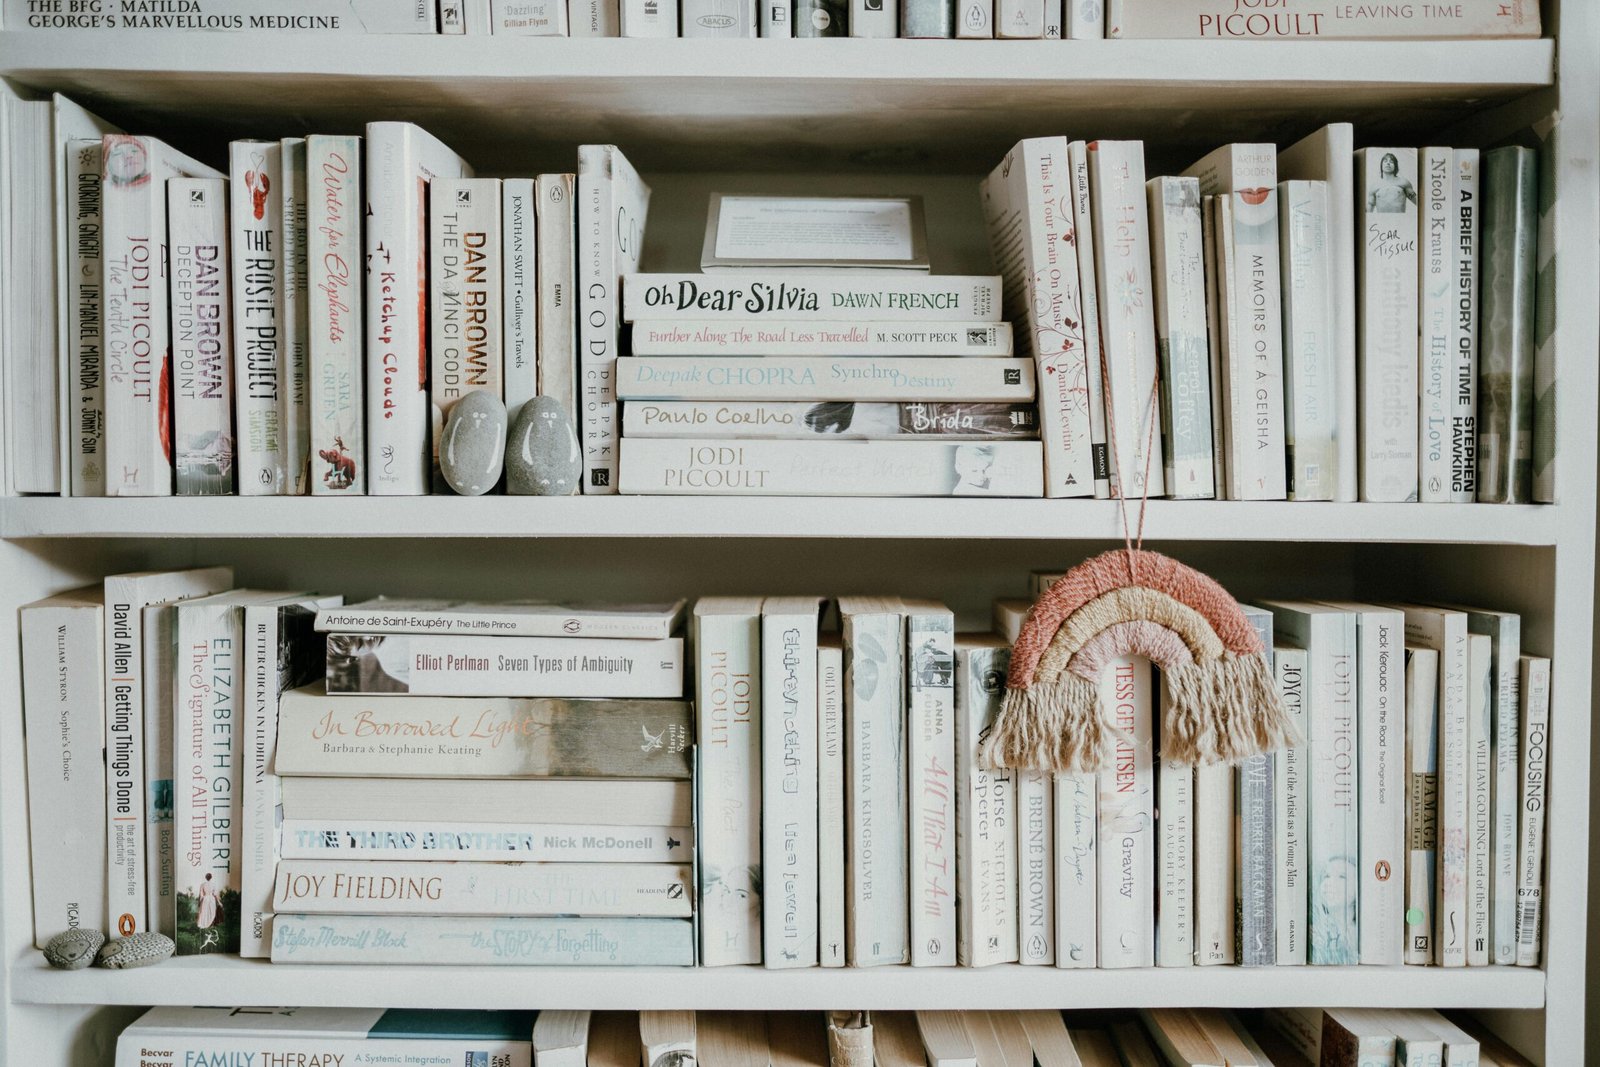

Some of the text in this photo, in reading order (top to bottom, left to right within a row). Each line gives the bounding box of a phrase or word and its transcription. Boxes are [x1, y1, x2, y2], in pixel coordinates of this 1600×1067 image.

[27, 0, 202, 13] THE BFG MATILDA
[28, 15, 340, 30] GEORGE'S MARVELLOUS MEDICINE
[1199, 13, 1324, 36] PICOULT
[1335, 3, 1463, 19] LEAVING TIME
[1431, 158, 1446, 274] Nicole Krauss
[319, 152, 350, 343] Water for Elephants
[463, 232, 487, 283] DAN
[442, 212, 462, 398] THE DA VINCI CODE
[512, 195, 525, 369] JONATHAN SWIFT Gulliver's Travels
[554, 284, 562, 307] EMMA
[644, 280, 960, 314] Oh Dear Silvia DAWN FRENCH
[1458, 189, 1473, 406] A BRIEF HISTORY OF TIME
[108, 254, 129, 383] The Tenth Circle
[127, 236, 151, 402] JODI PICOULT
[177, 245, 195, 399] DECEPTION POINT
[195, 245, 223, 399] DAN BROWN
[464, 290, 488, 385] BROWN
[649, 326, 958, 346] Further Along The Road Less Travelled M. SCOTT PECK
[378, 271, 397, 419] Ketchup Clouds
[1251, 254, 1270, 451] MEMOIRS OF A GEISHA
[637, 365, 816, 387] Deepak CHOPRA
[831, 363, 900, 383] Synchro
[264, 409, 279, 453] GRAEME
[587, 370, 599, 455] CHOPRA
[600, 370, 610, 455] DEEPAK
[641, 406, 793, 425] Paulo Coelho
[664, 469, 770, 488] PICOULT
[688, 447, 744, 469] JODI
[1452, 416, 1463, 492] HAWKING
[1463, 416, 1475, 492] STEPHEN
[325, 615, 517, 631] Antoine de Saint-Exupéry The Little Prince
[1379, 624, 1390, 648] Jack
[416, 654, 633, 675] Elliot Perlman Seven Types of Ambiguity
[825, 665, 836, 695] COLIN
[1379, 650, 1390, 692] Kerouac
[58, 624, 72, 782] WILLIAM STYRON Sophie's Choice
[112, 603, 134, 813] David Allen Getting Things Done
[255, 623, 266, 784] BUTTER CHICKEN IN LUDHIANA
[710, 650, 729, 748] PICOULT
[730, 672, 751, 724] JODI
[923, 693, 932, 742] FUNDER
[935, 699, 944, 735] ANNA
[1379, 696, 1388, 708] On
[1379, 709, 1388, 723] the
[322, 743, 482, 758] Barbara & Stephanie Keating
[825, 695, 836, 757] GREENLAND
[1330, 654, 1353, 812] JODI PICOULT
[1379, 724, 1388, 747] Road
[1455, 635, 1465, 818] AMANDA BROOKFIELD
[211, 638, 231, 874] ELIZABETH GILBERT
[1378, 762, 1387, 786] Original
[861, 720, 873, 901] BARBARA KINGSOLVER
[1379, 787, 1387, 804] Scroll
[1423, 773, 1437, 850] DAMAGE
[114, 824, 126, 866] productivity
[295, 829, 653, 851] THE THIRD BROTHER Nick McDonell
[1029, 795, 1046, 854] BRENÉ
[1475, 739, 1487, 934] WILLIAM GOLDING Lord of the Flies
[980, 859, 991, 912] EVANS
[995, 839, 1006, 925] NICHOLAS
[1118, 837, 1136, 899] Gravity
[1166, 824, 1175, 897] DAUGHTER
[1177, 776, 1186, 944] THE MEMORY KEEPER'S
[282, 872, 443, 904] JOY FIELDING
[1029, 859, 1044, 927] BROWN
[1518, 888, 1540, 897] 678
[253, 912, 263, 939] PICADOR
[140, 1048, 174, 1058] Becvar
